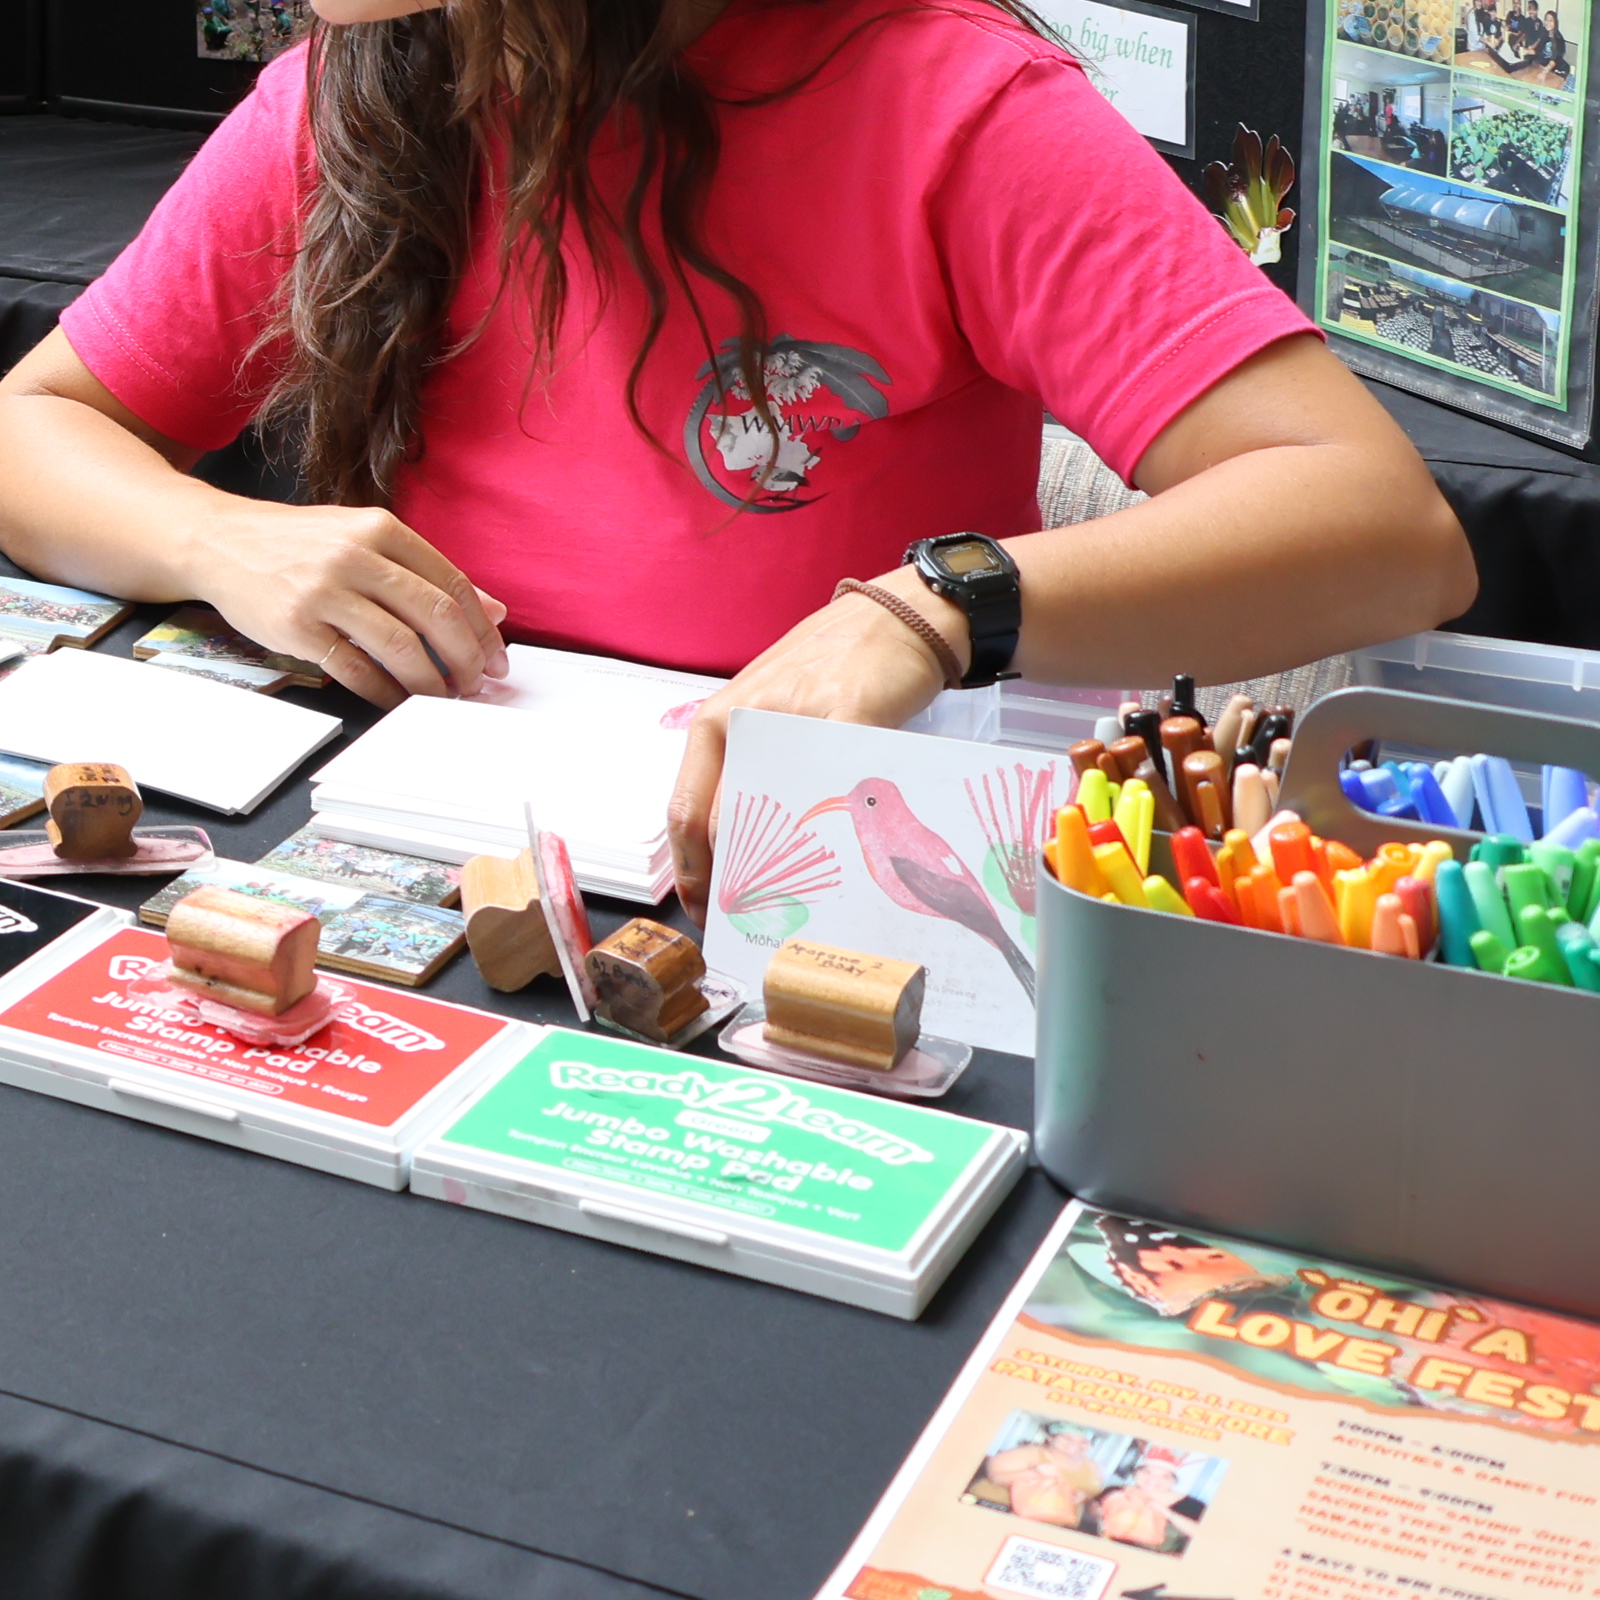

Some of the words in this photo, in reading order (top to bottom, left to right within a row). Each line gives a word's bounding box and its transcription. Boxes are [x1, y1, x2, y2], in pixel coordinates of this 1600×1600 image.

[1080, 17, 1108, 62] big
[1114, 31, 1174, 69] when
[92, 991, 206, 1028] Jumbo
[47, 1011, 100, 1032] Tampon
[102, 1026, 152, 1049] Encreur
[153, 1039, 208, 1061] Lavable
[220, 1057, 250, 1072] Non
[253, 1064, 307, 1088] Toxique
[321, 1081, 368, 1103] Rouge
[125, 1016, 231, 1054] Stamp
[247, 1046, 317, 1074] Pad
[541, 1101, 670, 1141] Jumbo
[684, 1132, 875, 1191] Washable
[584, 1128, 711, 1170] Stamp
[720, 1160, 803, 1192] Pad
[709, 1177, 743, 1192] Non
[747, 1183, 809, 1210] Toxique
[827, 1204, 861, 1221] Vert
[1194, 1301, 1401, 1376] LOVE
[992, 1358, 1172, 1415] PATAGONIA
[1179, 1405, 1296, 1446] STORE
